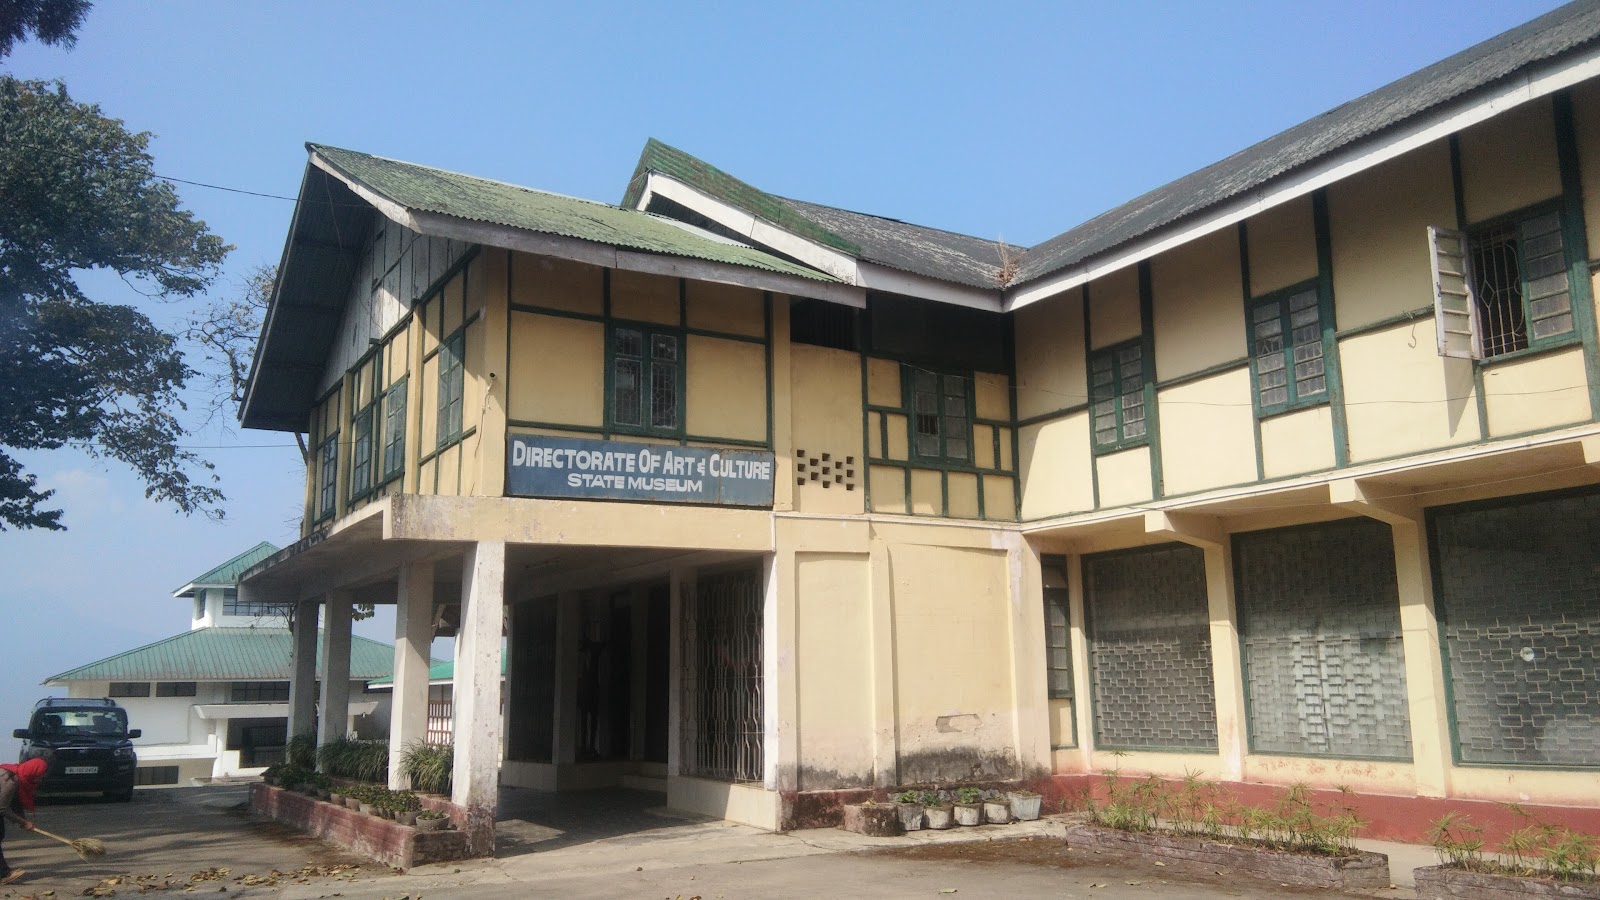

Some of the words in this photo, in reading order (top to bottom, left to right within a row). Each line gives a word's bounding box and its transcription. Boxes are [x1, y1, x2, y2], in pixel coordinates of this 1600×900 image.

[513, 440, 635, 472] DIRECTORATE
[639, 449, 661, 473] OF
[662, 451, 695, 476] ART
[697, 458, 705, 476] &
[709, 453, 771, 480] CULTURE
[567, 472, 624, 489] STATE
[627, 477, 703, 493] MUSEUM
